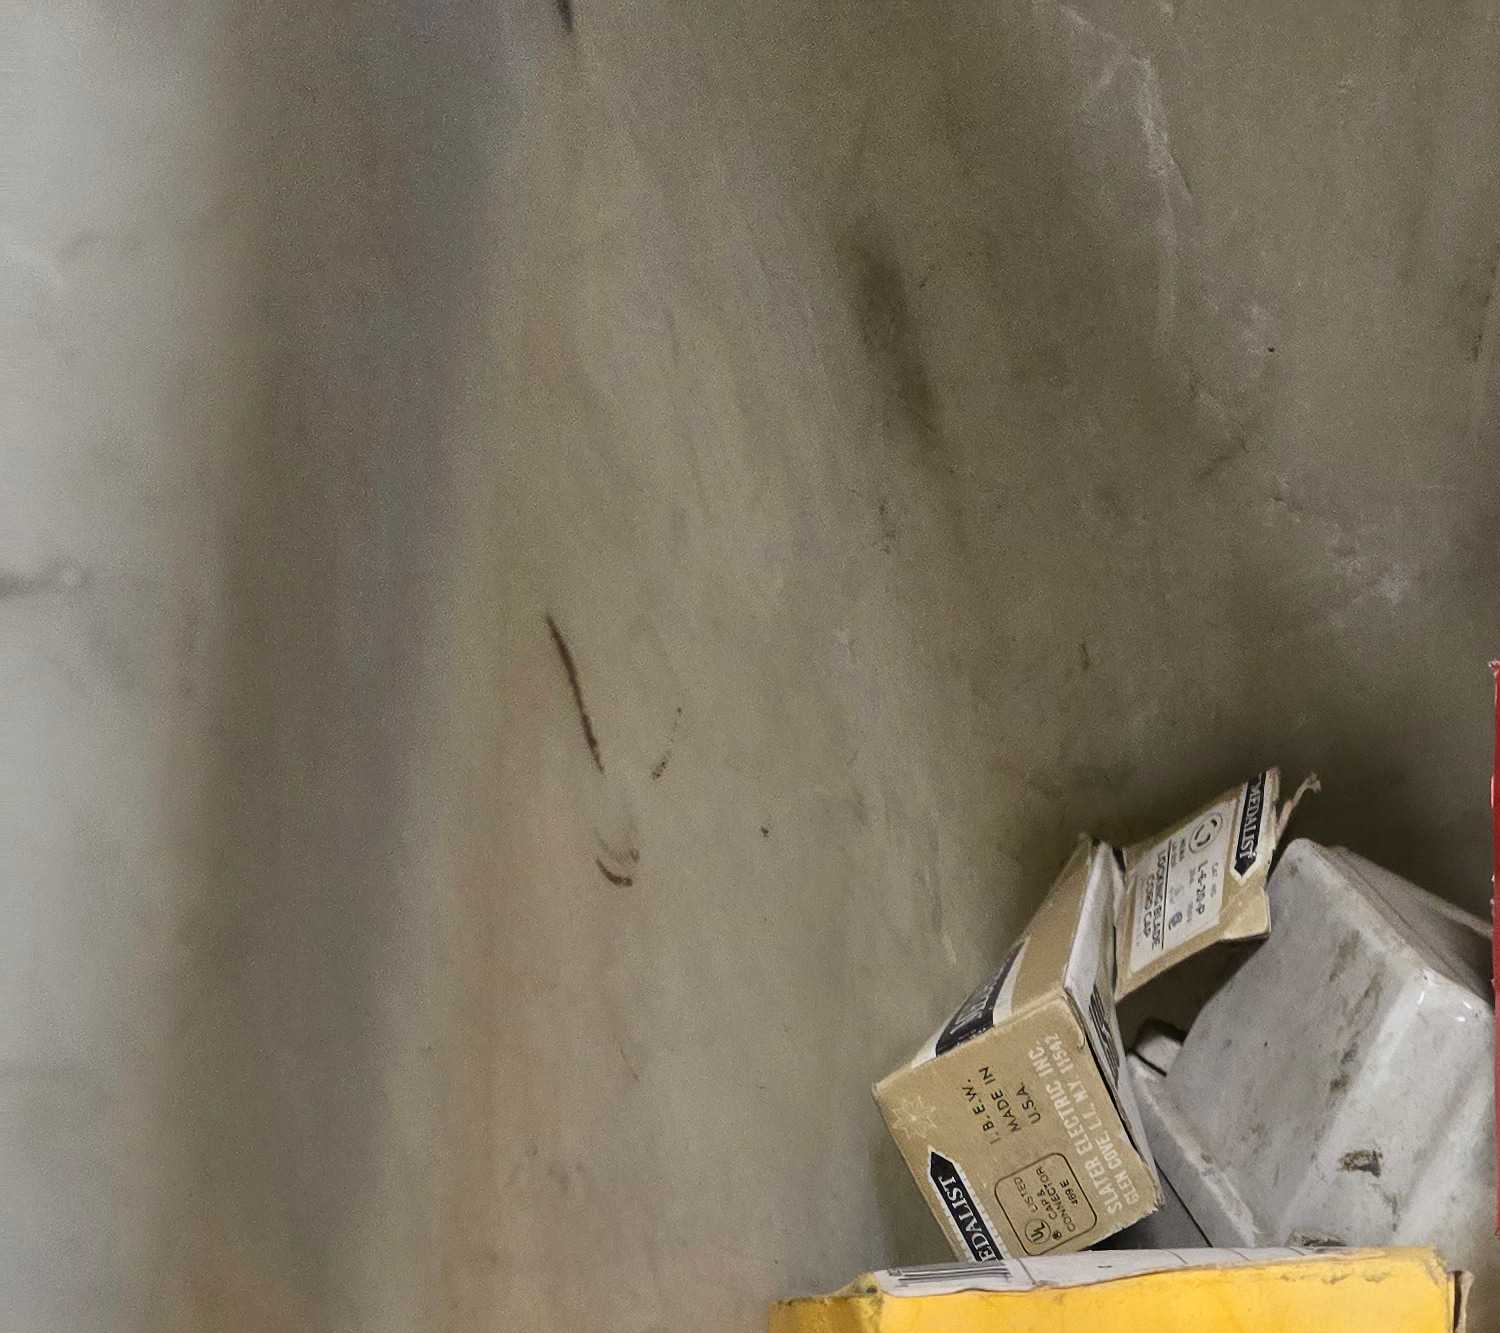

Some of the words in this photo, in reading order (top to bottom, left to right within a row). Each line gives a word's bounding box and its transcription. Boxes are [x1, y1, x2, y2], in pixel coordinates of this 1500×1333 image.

[978, 1065, 996, 1085] IN
[1011, 1080, 1042, 1125] U.S.A.
[990, 1088, 1022, 1134] MADE
[1042, 1078, 1095, 1157] ELECTRIC
[1033, 1164, 1077, 1234] CONNECTOR
[1082, 1153, 1126, 1215] SLATER
[936, 1169, 998, 1264] EDALIST
